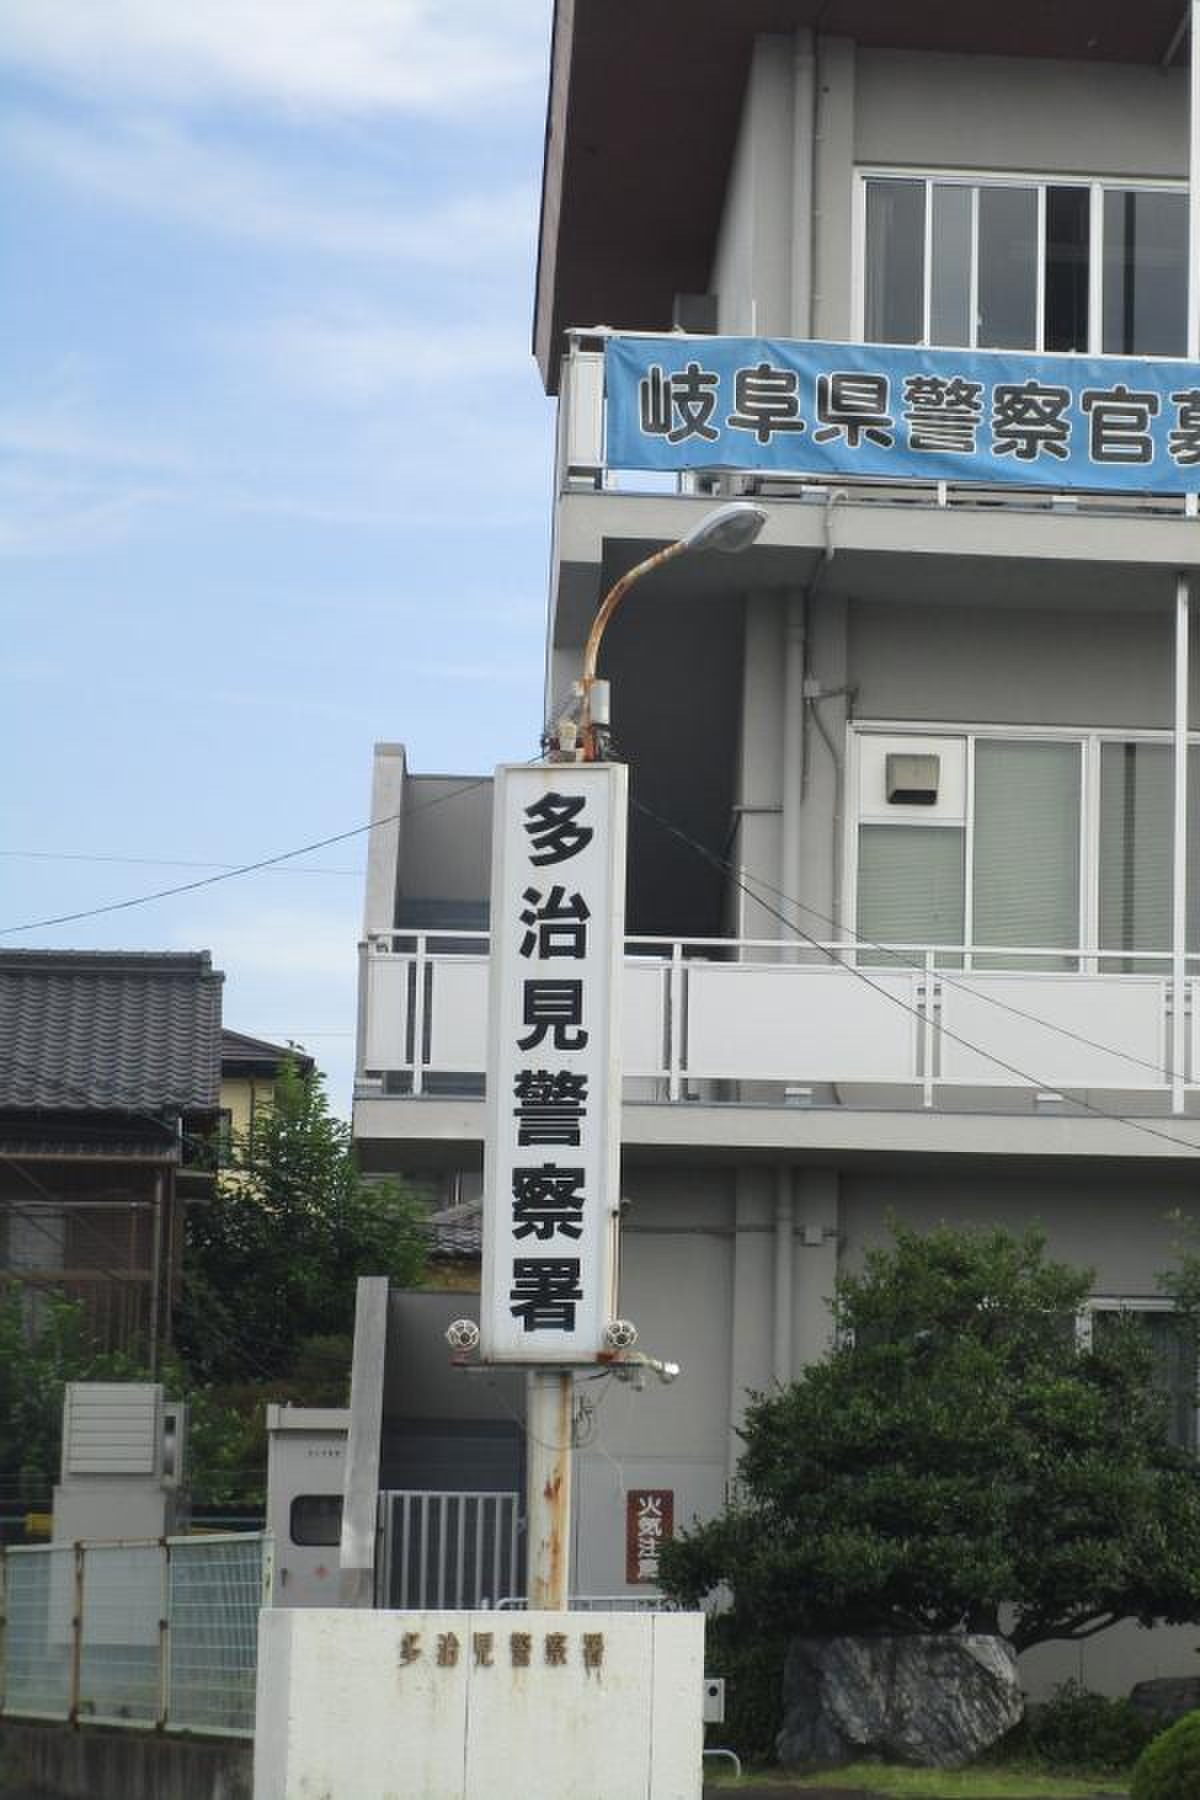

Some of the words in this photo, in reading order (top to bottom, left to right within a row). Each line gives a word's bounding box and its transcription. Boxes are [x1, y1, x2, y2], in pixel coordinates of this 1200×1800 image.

[510, 791, 594, 1333] 多治見警察署
[398, 1631, 605, 1668] 多治見警察署
